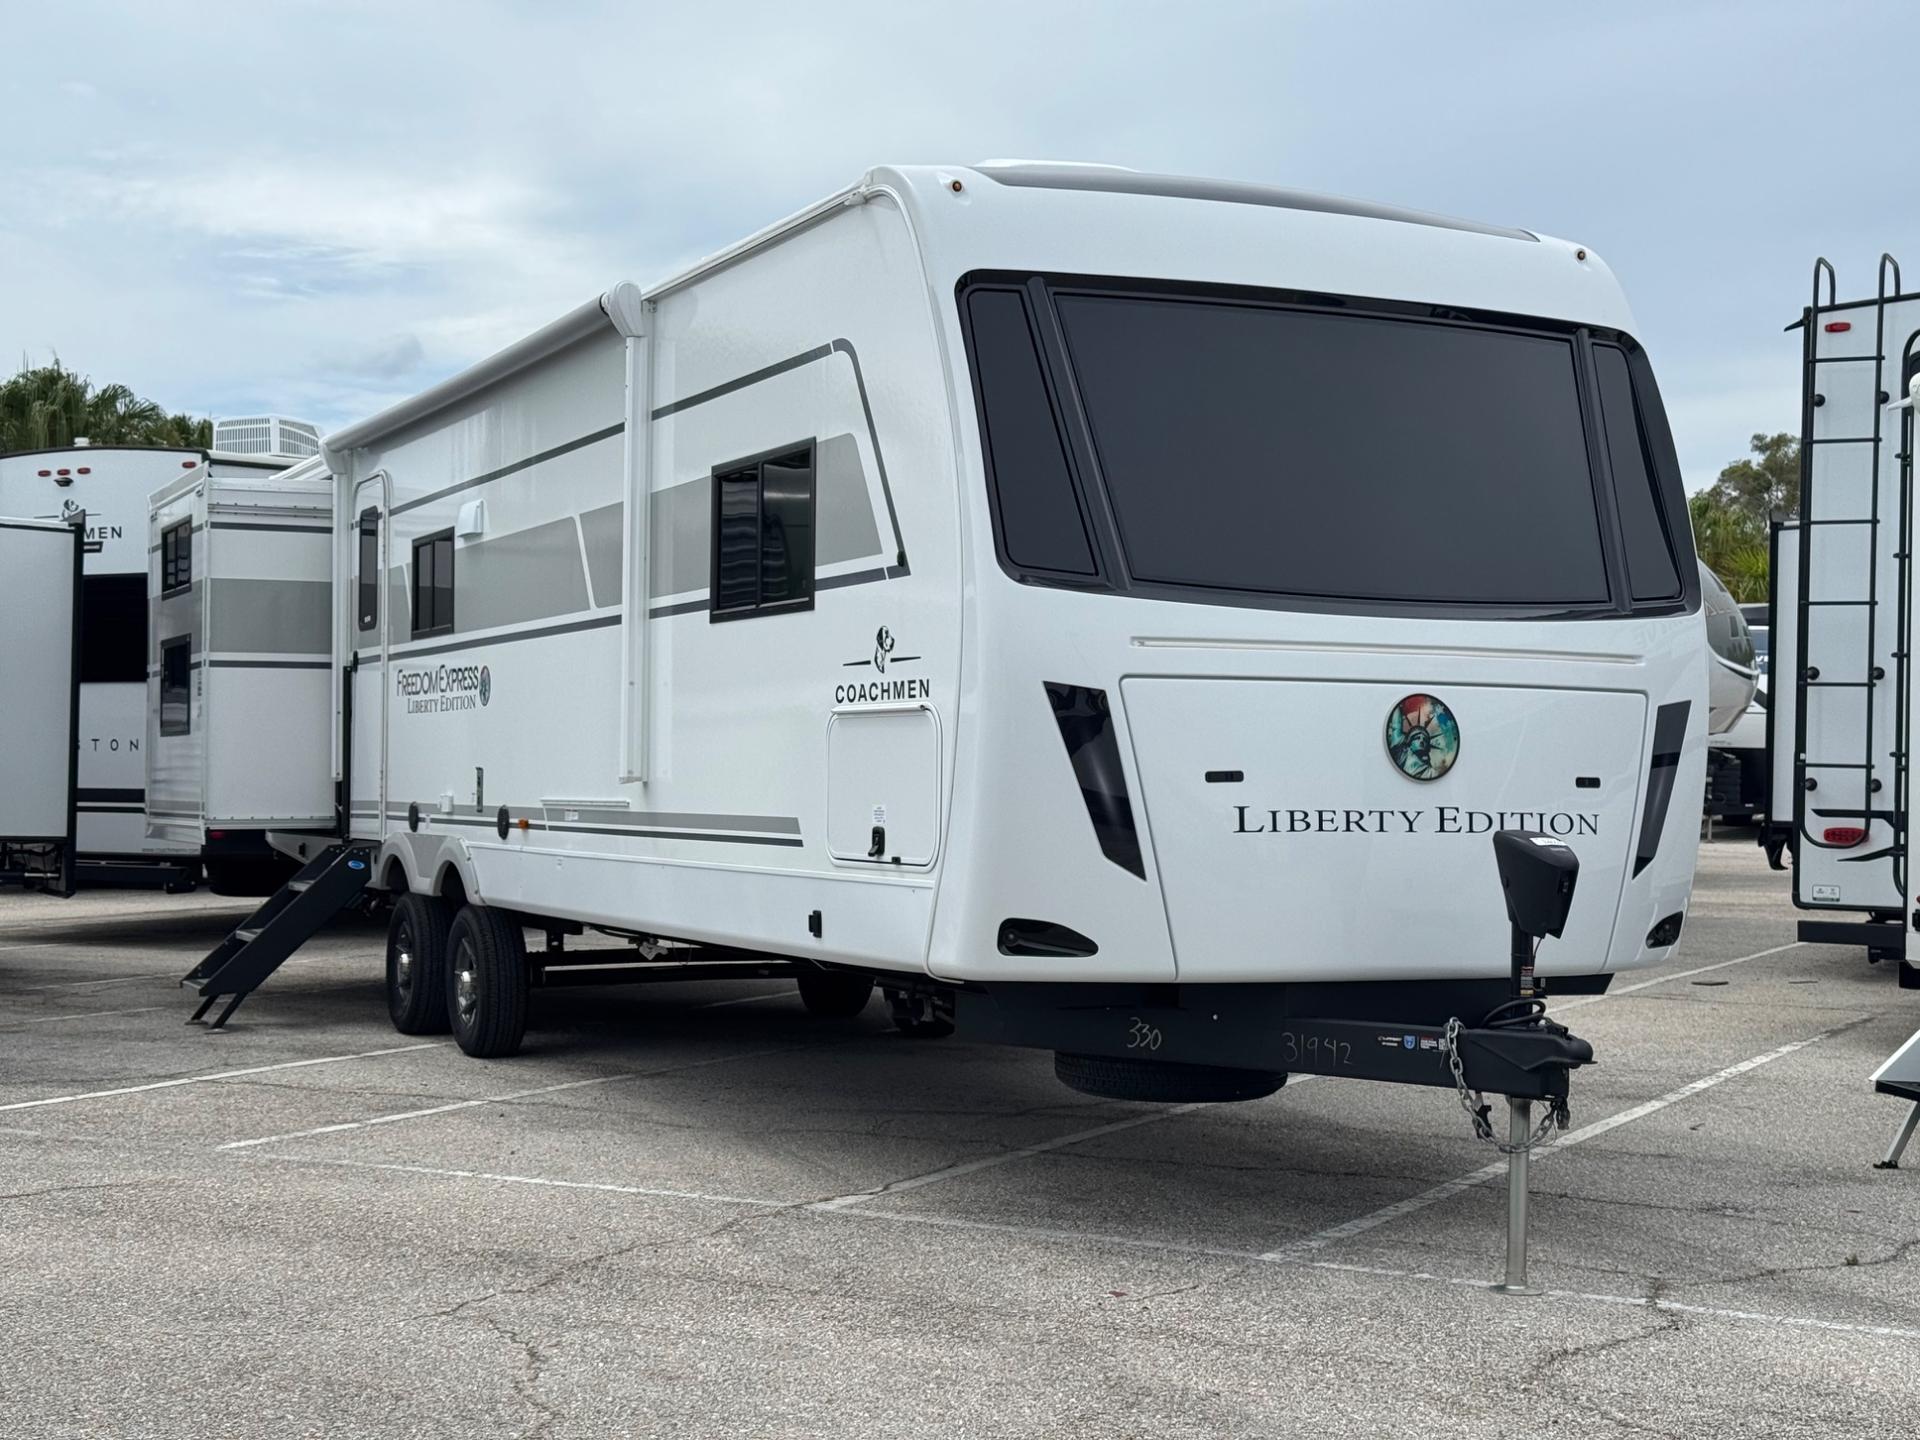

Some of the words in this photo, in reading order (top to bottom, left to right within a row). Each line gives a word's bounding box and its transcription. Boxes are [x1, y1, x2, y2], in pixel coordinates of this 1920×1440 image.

[407, 698, 439, 714] LIBERTY
[440, 695, 476, 712] EDITION
[835, 678, 930, 704] COACHMEN
[78, 738, 139, 752] TON
[1232, 805, 1425, 834] LIBERTY
[1434, 806, 1600, 836] EDITION
[1126, 1016, 1162, 1050] 330
[1281, 1031, 1353, 1066] 31942
